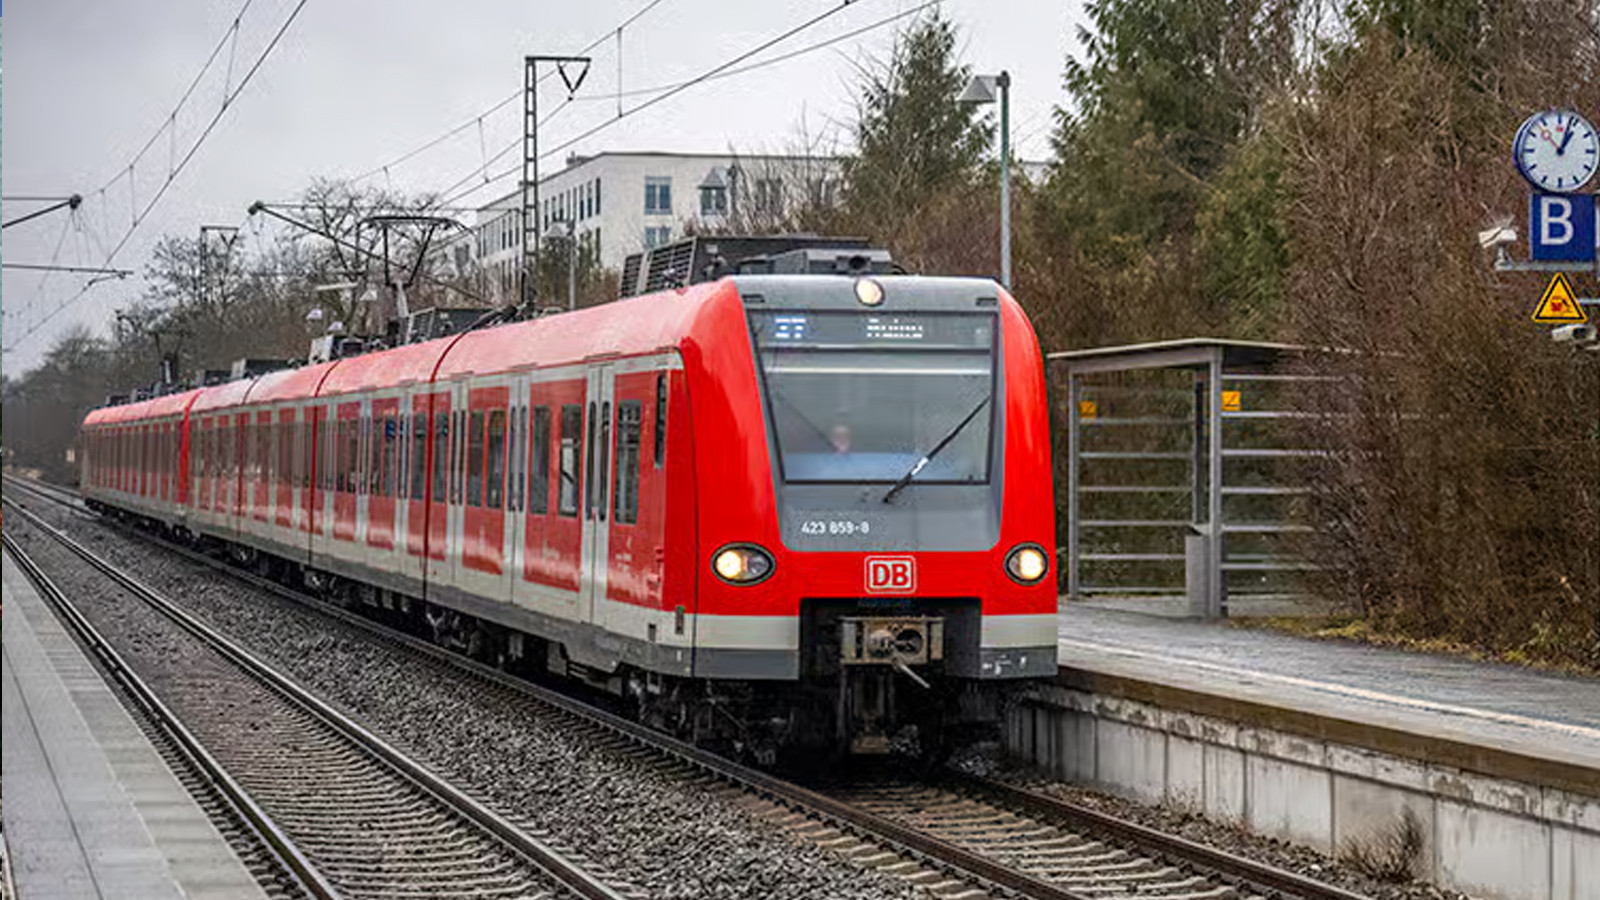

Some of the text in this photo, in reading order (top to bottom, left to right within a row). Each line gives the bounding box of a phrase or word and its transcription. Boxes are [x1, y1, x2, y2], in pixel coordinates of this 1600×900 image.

[1540, 197, 1574, 246] B
[801, 521, 826, 534] 423
[869, 560, 911, 588] DB
